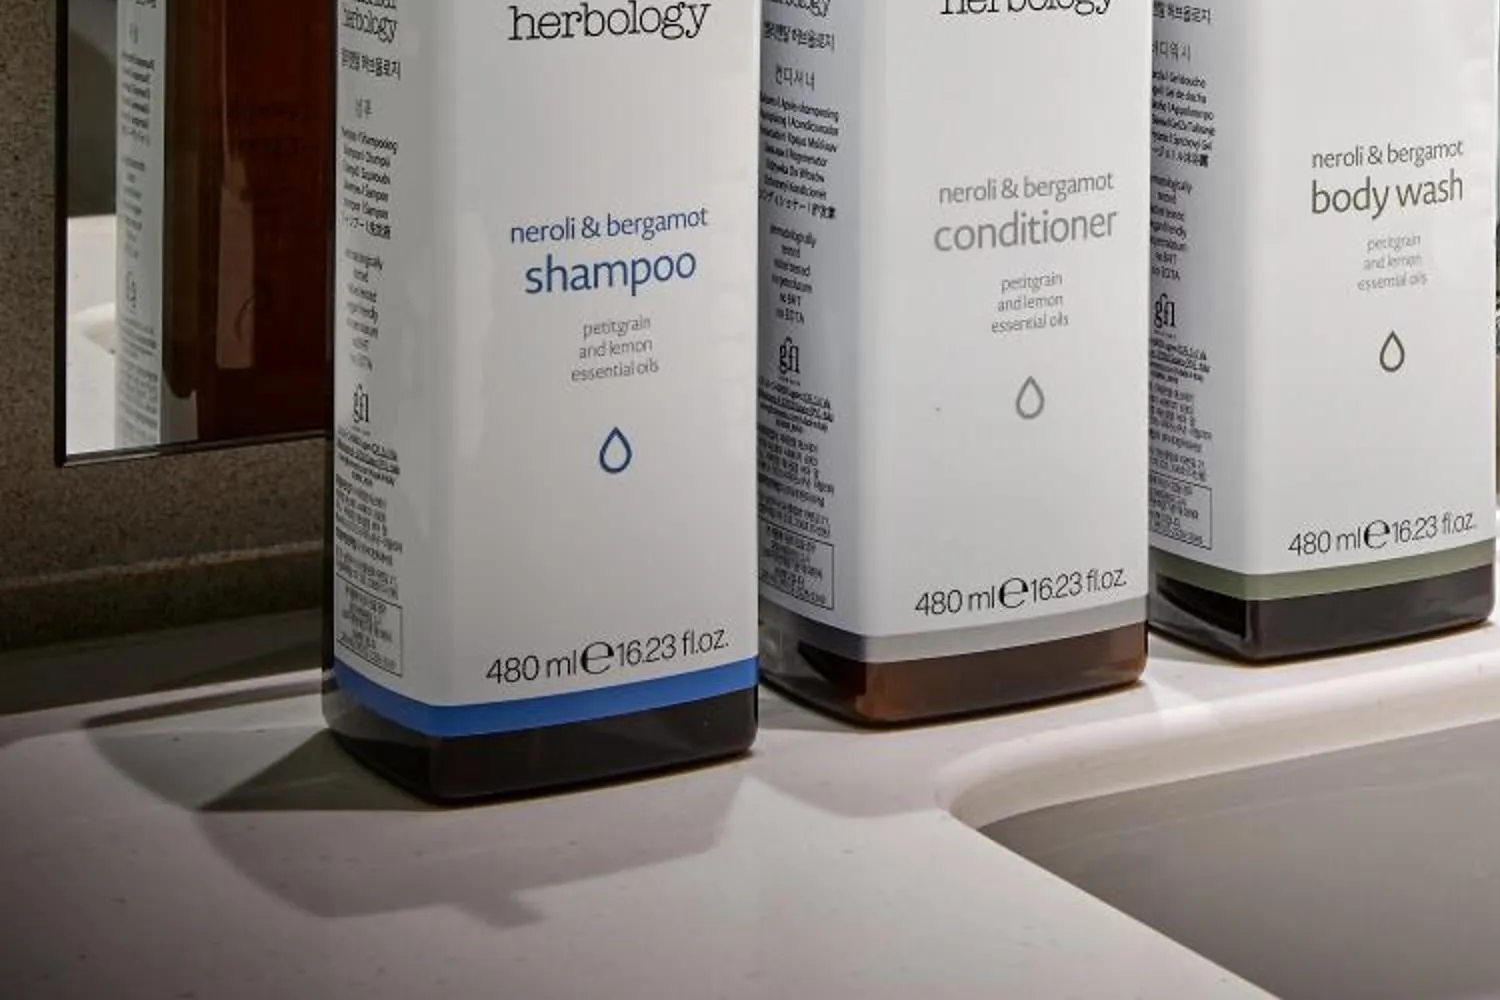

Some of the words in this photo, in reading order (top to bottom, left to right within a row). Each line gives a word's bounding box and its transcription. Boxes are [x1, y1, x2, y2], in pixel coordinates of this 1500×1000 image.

[1311, 144, 1364, 169] neroli
[1367, 145, 1384, 166] &
[1387, 139, 1465, 168] bergamot
[939, 177, 998, 204] neroli
[1001, 177, 1019, 200] &
[1023, 171, 1115, 203] bergamot
[1311, 174, 1390, 221] body
[1394, 167, 1464, 208] wash
[511, 216, 576, 244] neroli
[580, 215, 602, 239] &
[607, 207, 709, 241] bergamot
[933, 208, 1120, 252] conditioner
[524, 252, 697, 297] shampoo
[1363, 255, 1385, 271] and
[1001, 270, 1064, 294] petitgrain
[997, 296, 1022, 313] and
[1023, 293, 1064, 310] lemon
[582, 314, 652, 341] petitgrain
[991, 313, 1047, 334] essential
[1050, 311, 1069, 328] oils
[578, 340, 606, 360] and
[608, 336, 654, 357] lemon
[570, 361, 635, 383] essential
[636, 359, 660, 376] oils
[1288, 530, 1331, 557] 480
[1336, 526, 1361, 551] ml
[914, 588, 964, 617] 480
[968, 585, 996, 612] ml
[1031, 571, 1083, 604] 16.23
[486, 654, 540, 684] 480
[546, 650, 577, 678] ml
[616, 633, 678, 667] 16.23
